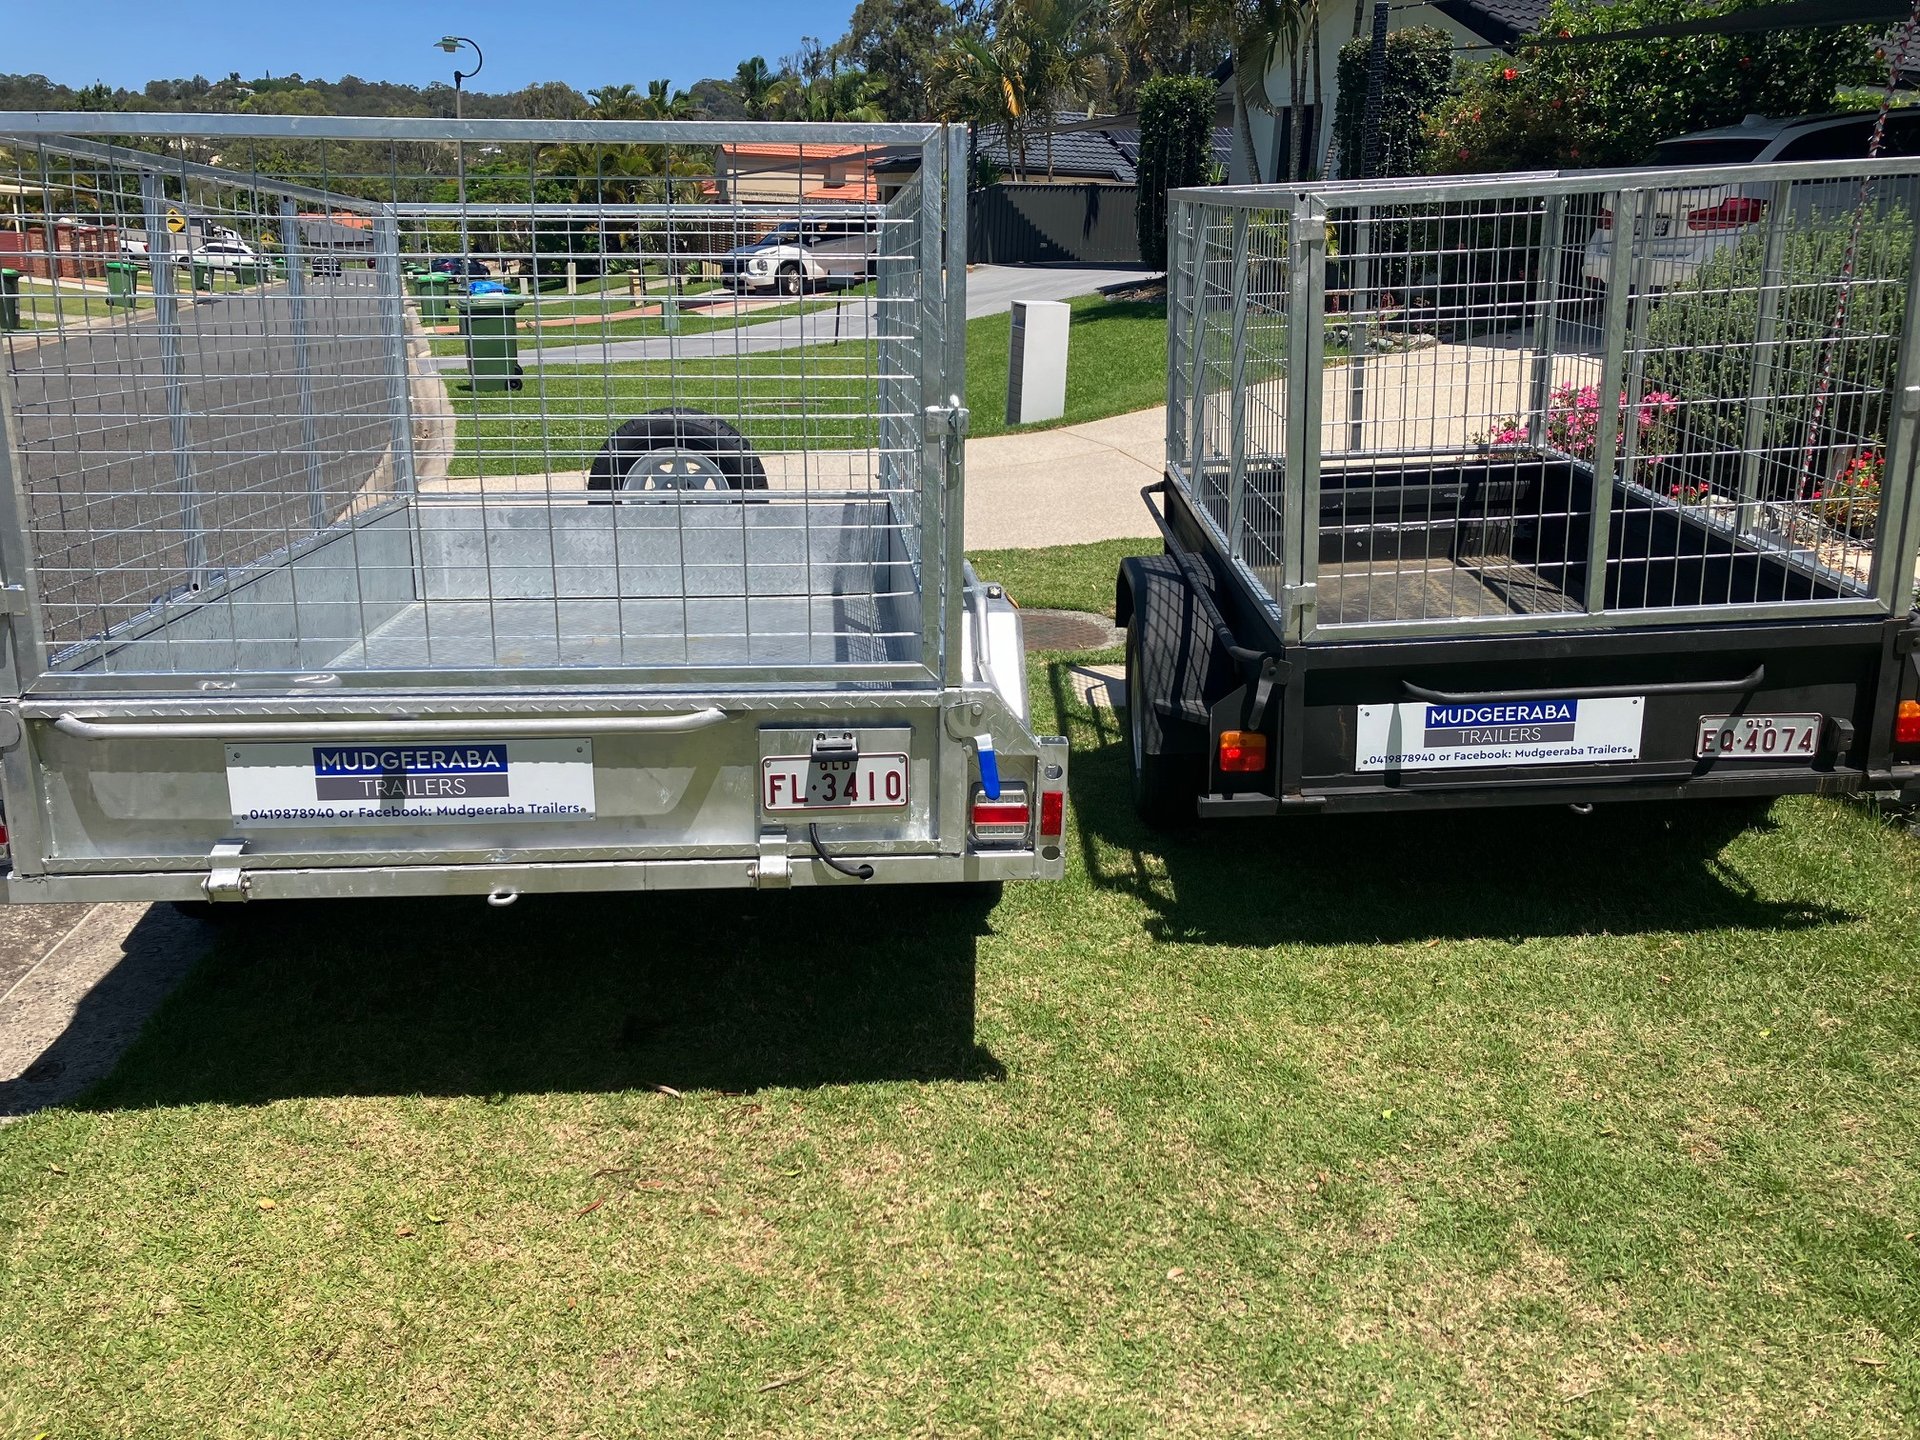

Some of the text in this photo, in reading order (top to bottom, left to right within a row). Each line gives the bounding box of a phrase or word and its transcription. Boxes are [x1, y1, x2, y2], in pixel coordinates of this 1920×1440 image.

[1430, 704, 1571, 725] MUDGEERABA
[1746, 719, 1773, 728] QLD
[1458, 727, 1542, 744] TRAILERS
[320, 749, 501, 771] MUDGEERABA
[1369, 744, 1627, 765] 0419878940 or Facebook: Mudgeeraba Trailers
[820, 761, 850, 771] QLD
[358, 778, 467, 797] TRAILERS
[250, 802, 580, 820] 0419878940 or Facebook: Mudgeeraba Trailers
